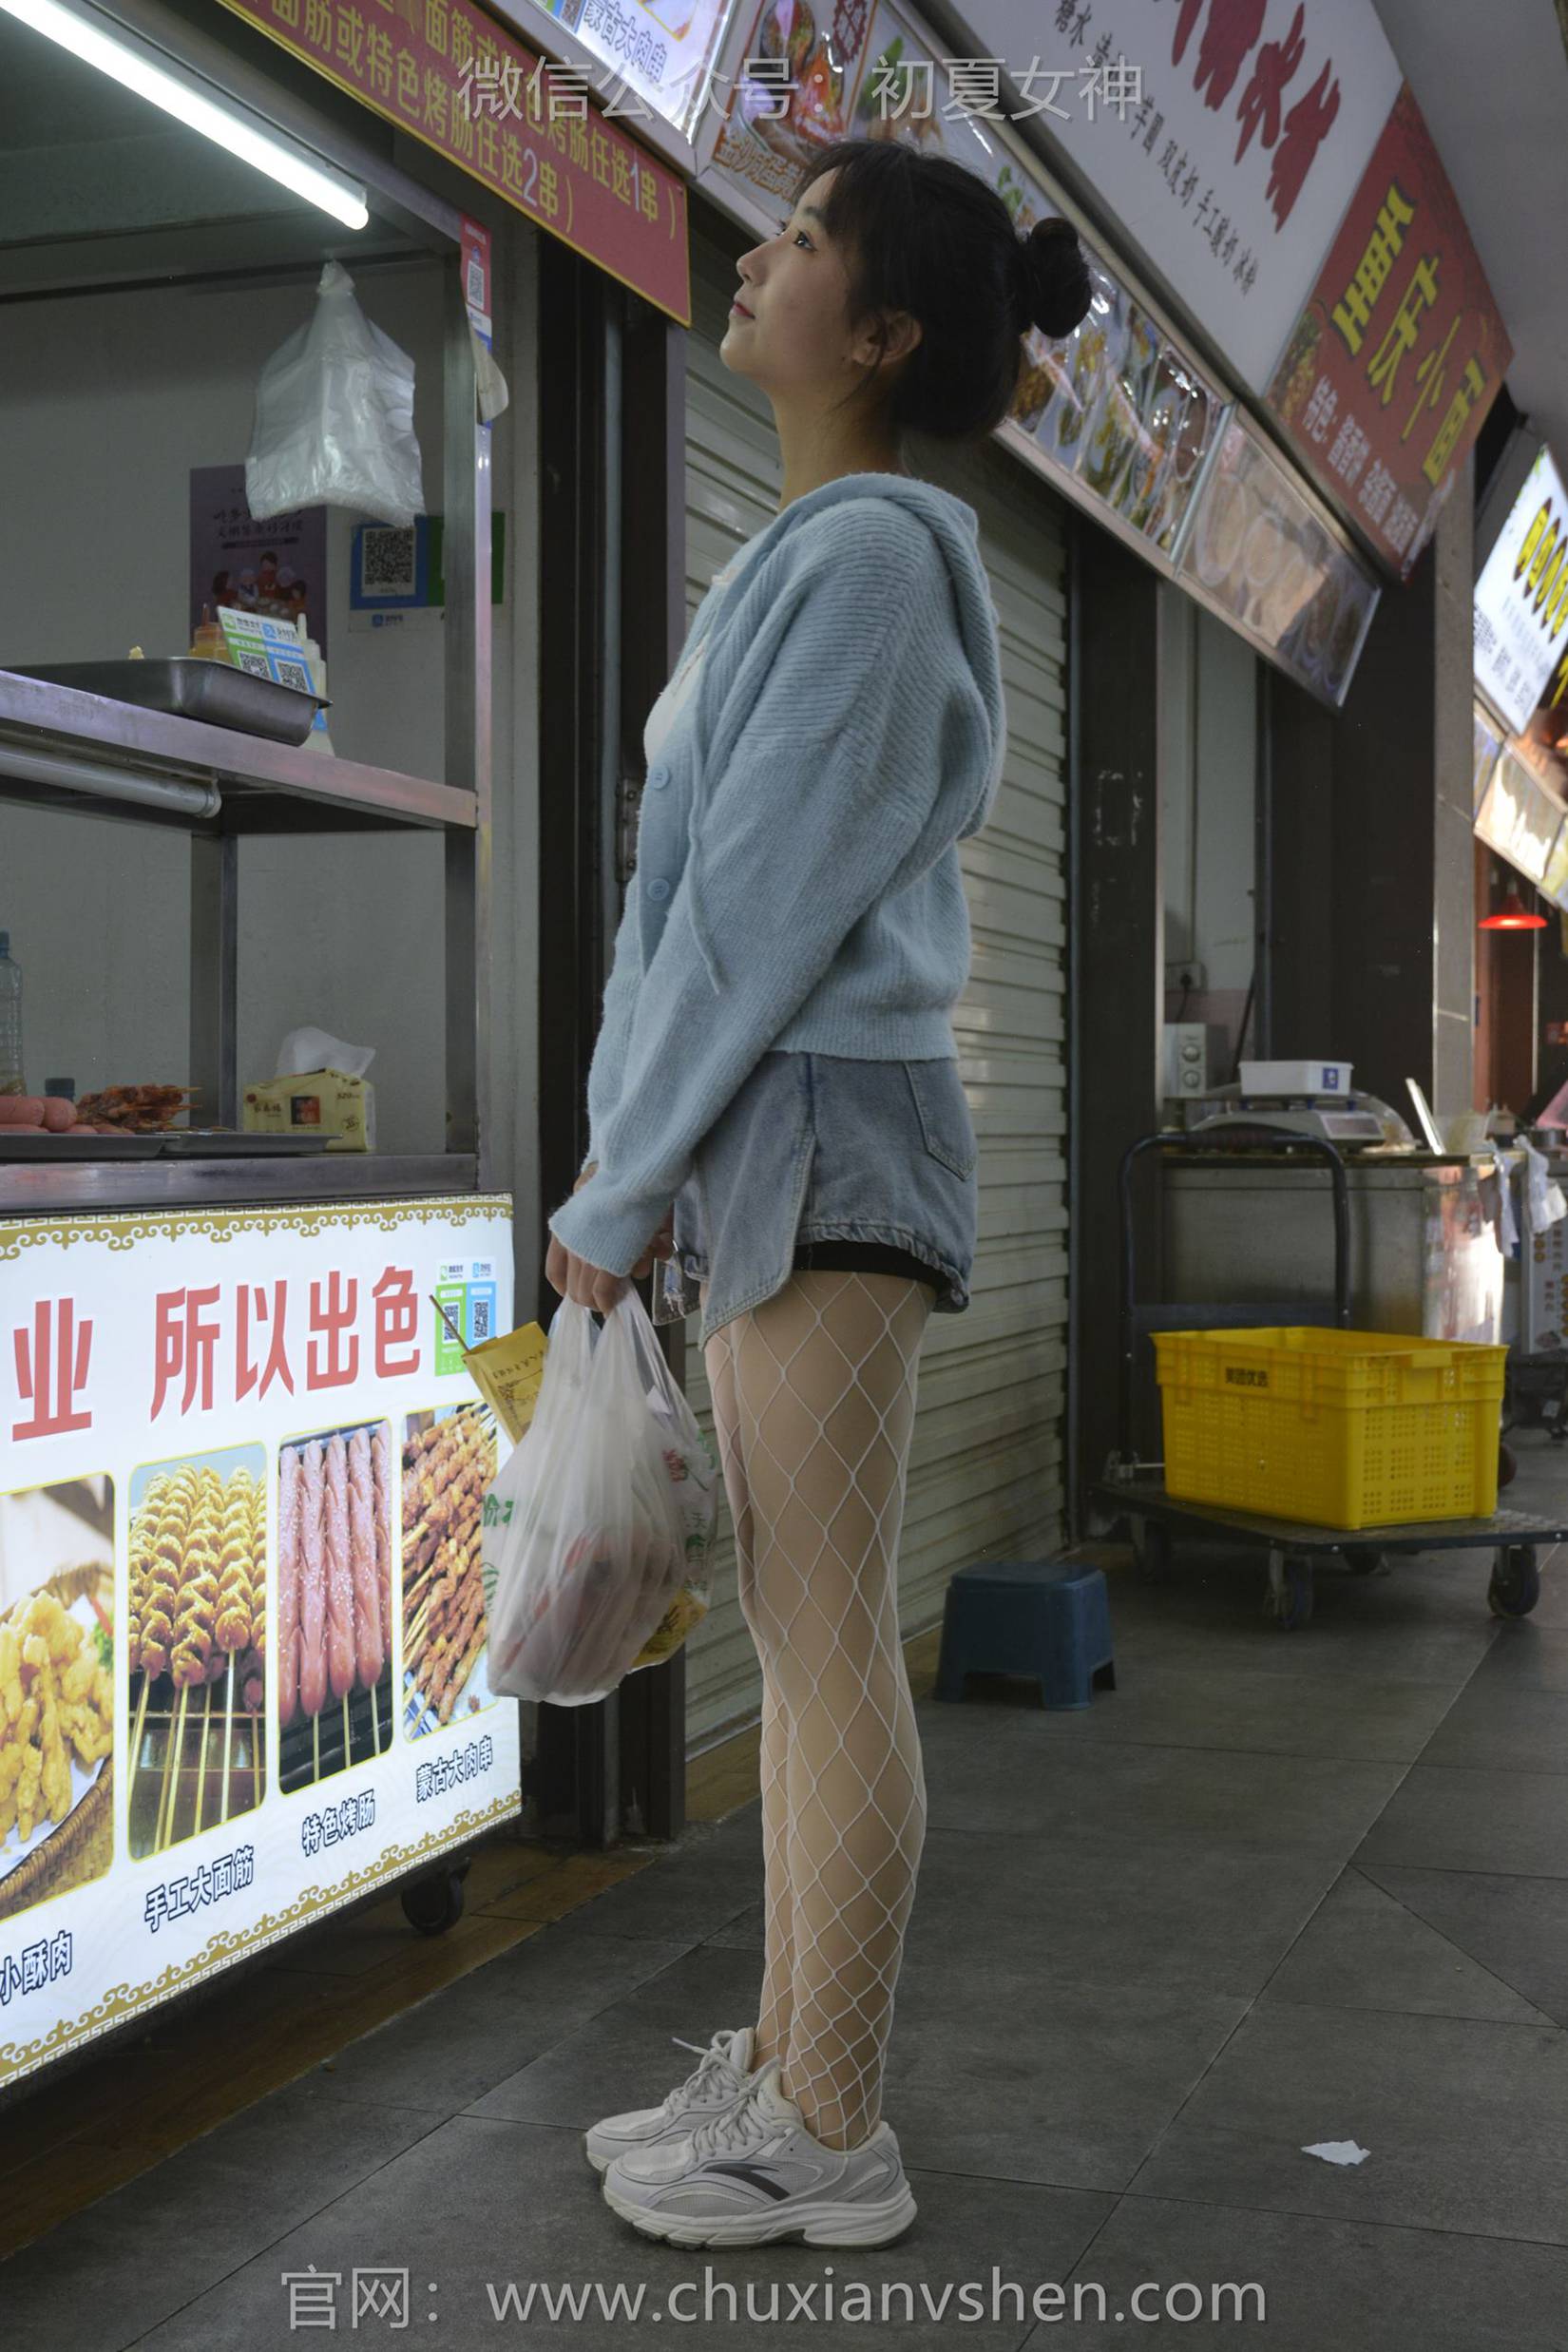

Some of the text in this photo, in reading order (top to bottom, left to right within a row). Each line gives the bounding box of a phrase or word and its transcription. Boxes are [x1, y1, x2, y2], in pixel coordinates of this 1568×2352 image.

[1332, 182, 1486, 486] 重庆小面
[12, 1265, 421, 1442] 业 所以出色
[415, 1735, 493, 1803] 蒙古大肉串
[301, 1789, 376, 1856] 特色烤肠
[144, 1845, 255, 1932] 手工大面筋
[0, 1930, 72, 2005] 小酥肉
